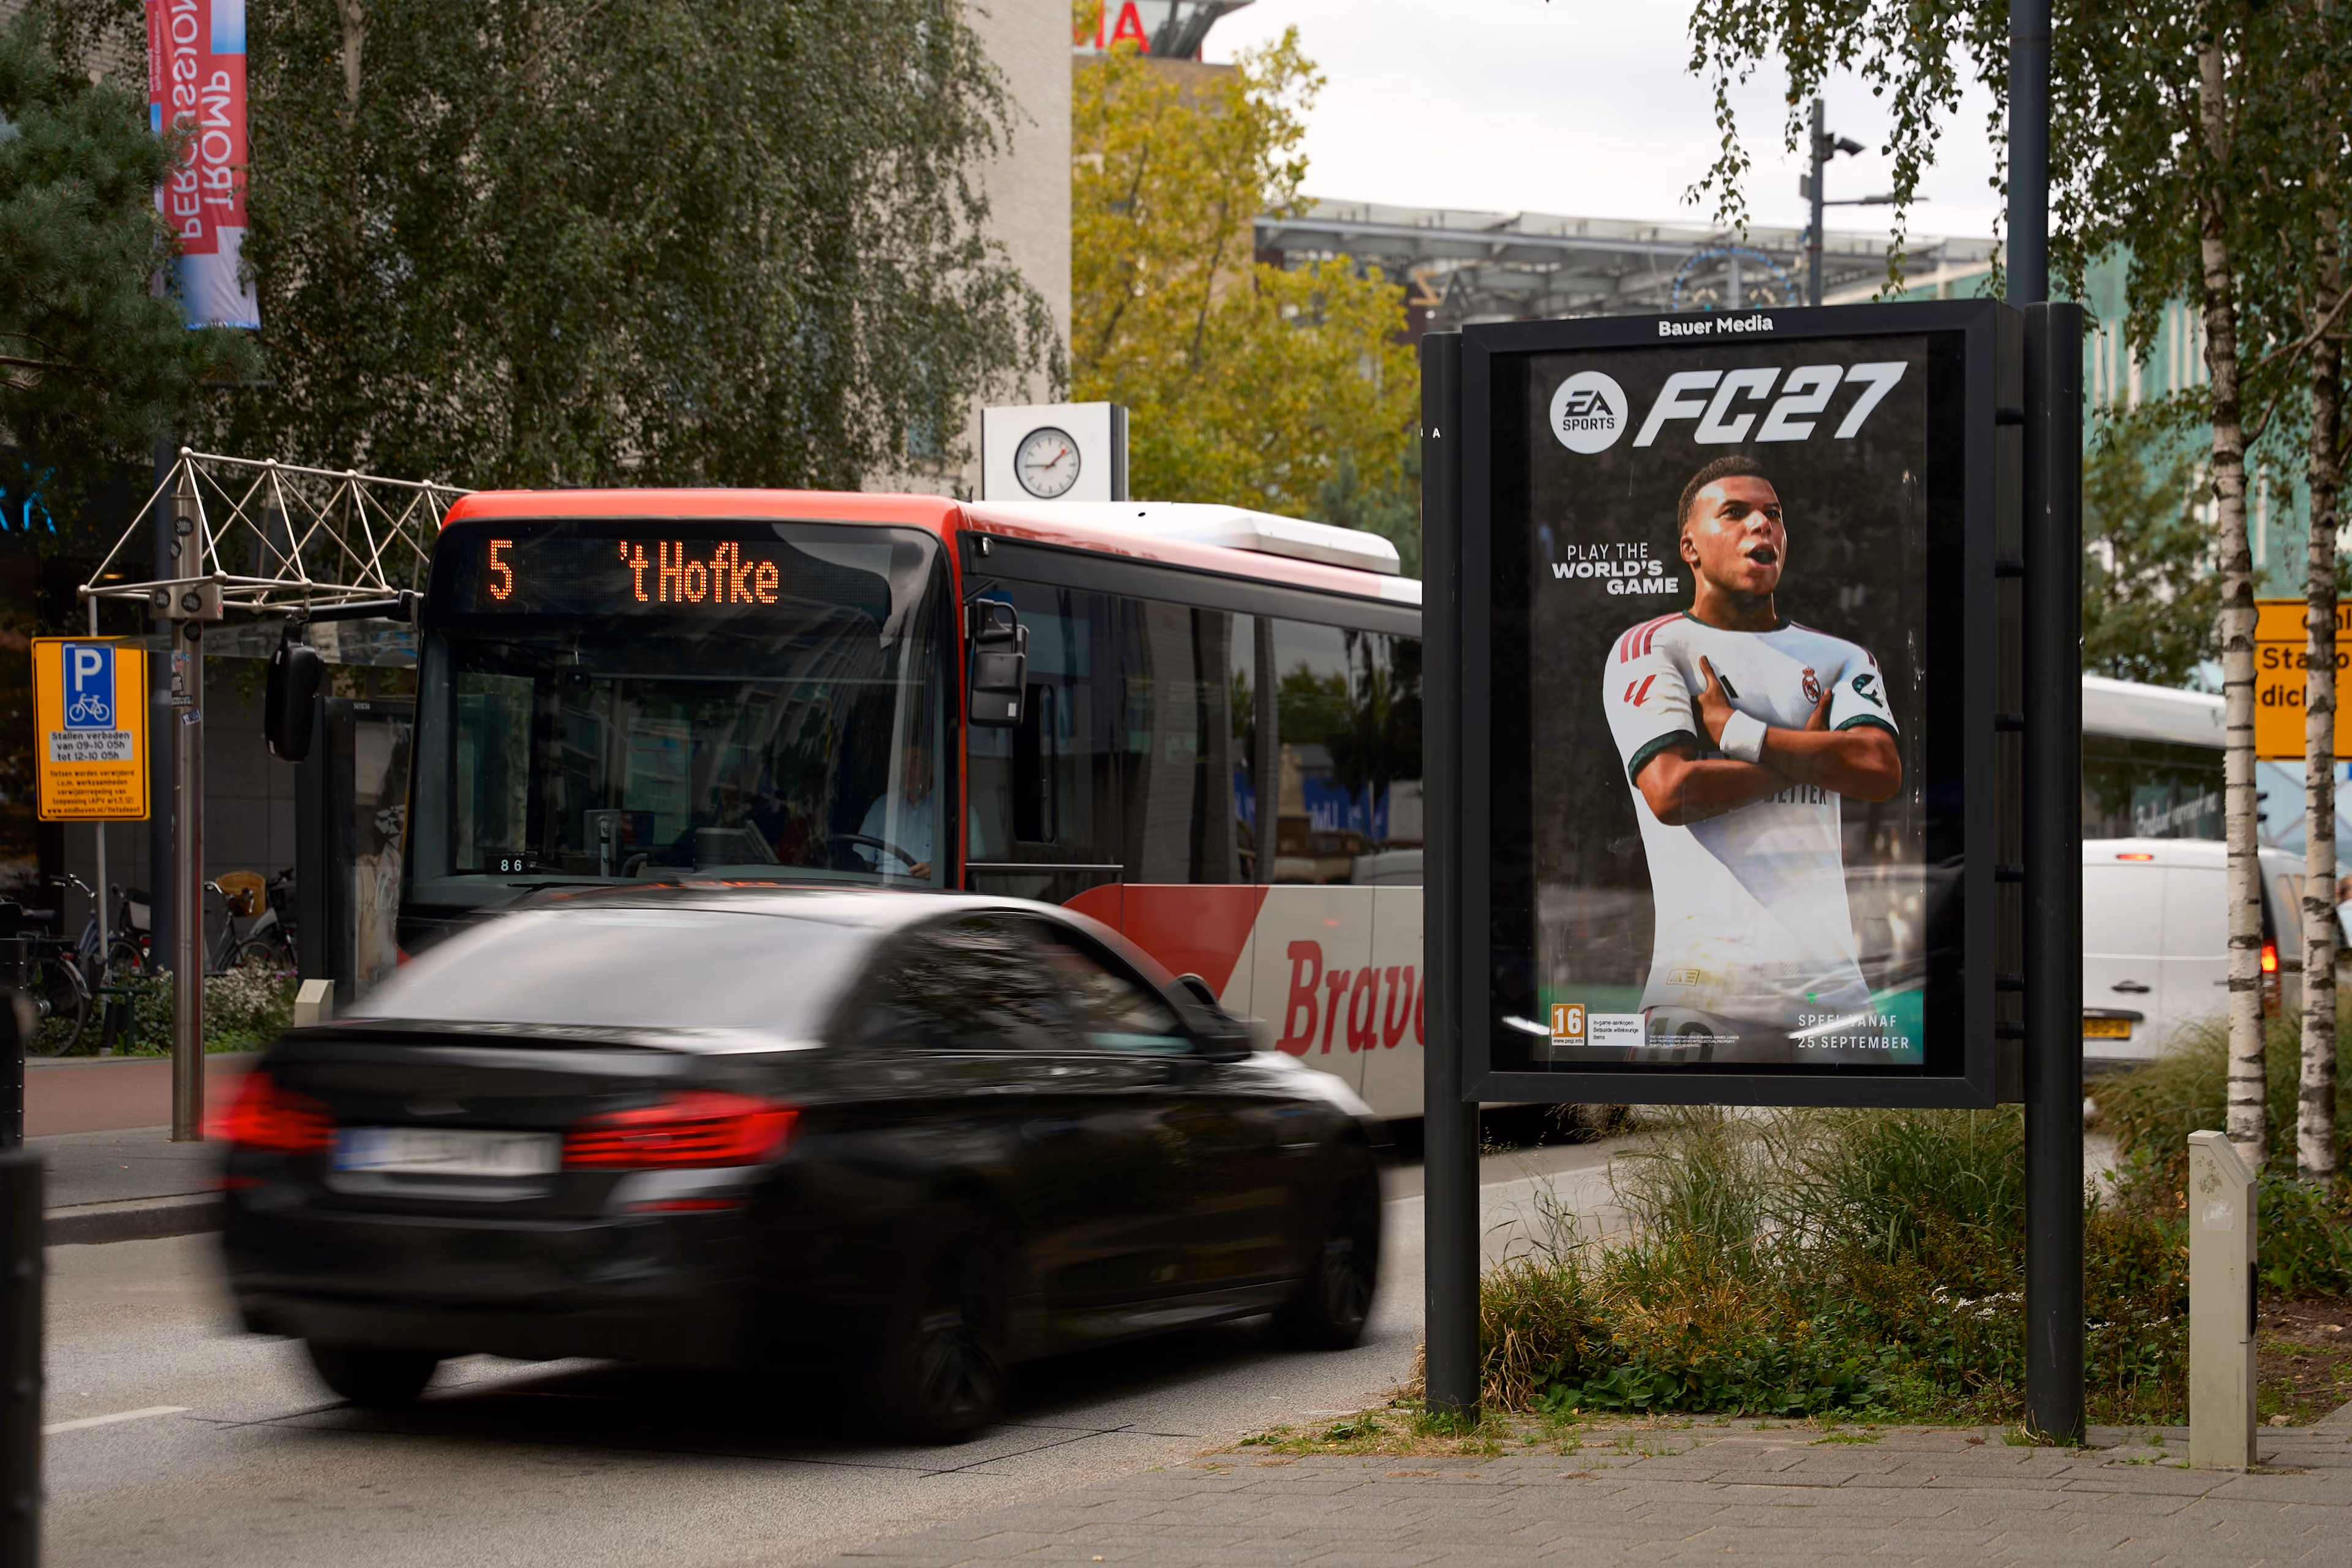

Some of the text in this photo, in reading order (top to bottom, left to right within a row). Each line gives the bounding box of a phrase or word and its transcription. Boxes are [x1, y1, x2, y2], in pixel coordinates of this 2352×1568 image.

[1659, 314, 1774, 337] Bauer Media
[1564, 390, 1614, 417] EA
[1562, 417, 1616, 431] SPORTS
[1567, 542, 1648, 560] PLAY THE
[490, 540, 779, 603] 5 't Hofke
[1551, 560, 1663, 579] WORLD'S
[1607, 577, 1678, 595] GAME
[75, 649, 102, 692] P
[52, 731, 130, 741] Stallen verboden
[58, 753, 71, 761] tot
[1555, 1008, 1581, 1035] 16
[1798, 1036, 1909, 1049] 25 SEPTEMBER
